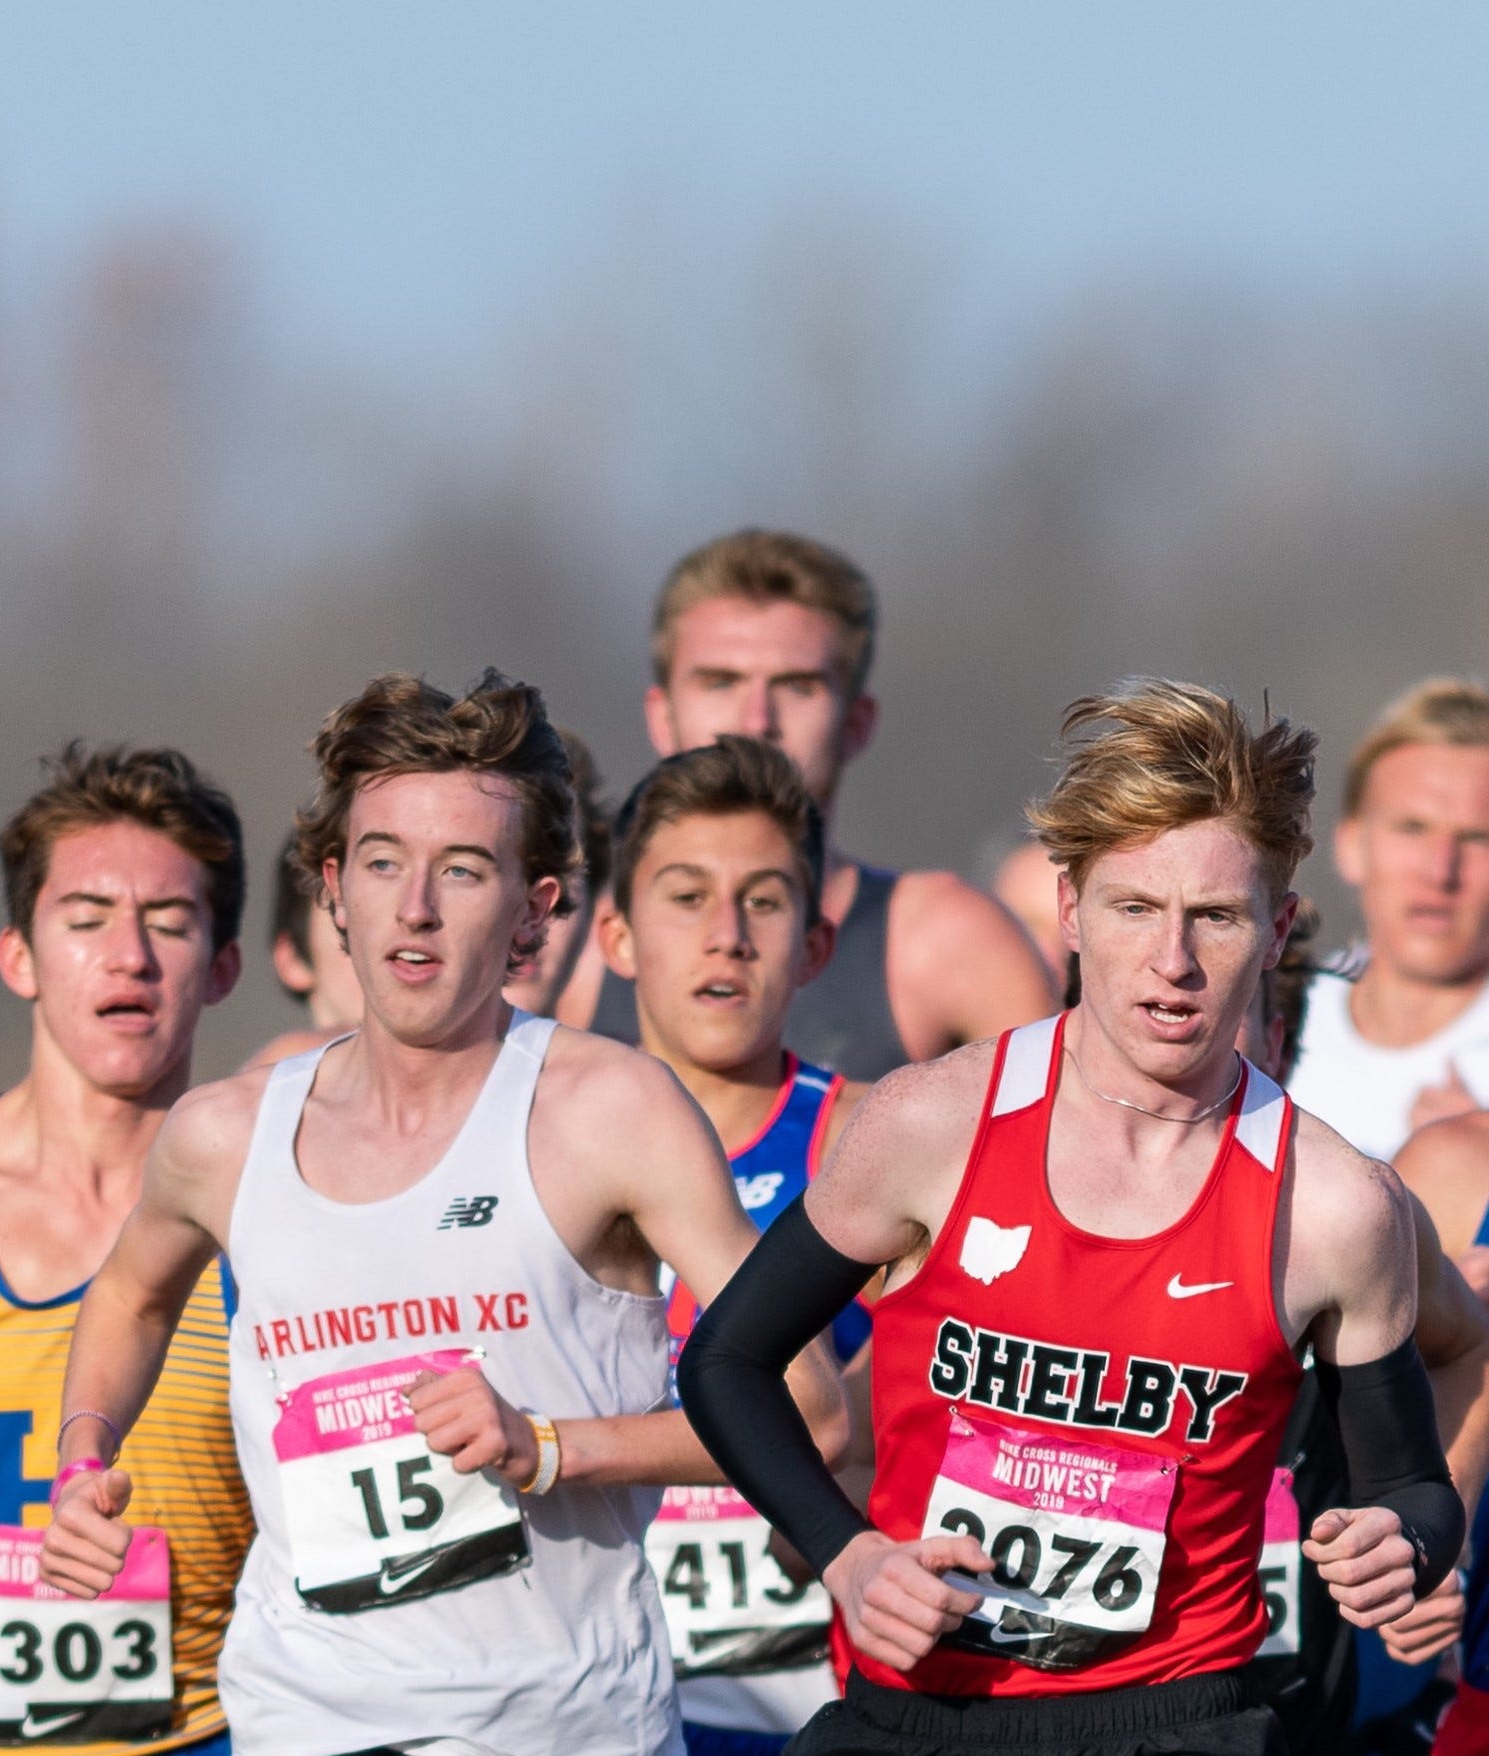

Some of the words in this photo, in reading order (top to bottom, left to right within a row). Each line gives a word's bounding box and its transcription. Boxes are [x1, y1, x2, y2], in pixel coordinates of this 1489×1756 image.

[253, 1294, 461, 1361] ARLINGTON
[472, 1291, 529, 1332] XC
[928, 1315, 1249, 1443] SHELBY
[315, 1388, 416, 1435] MIDWES
[992, 1452, 1116, 1504] MIDWEST
[1023, 1446, 1056, 1463] CROSS
[1059, 1451, 1118, 1473] REGIONALS
[351, 1455, 444, 1540] 15
[1032, 1492, 1065, 1510] 2019
